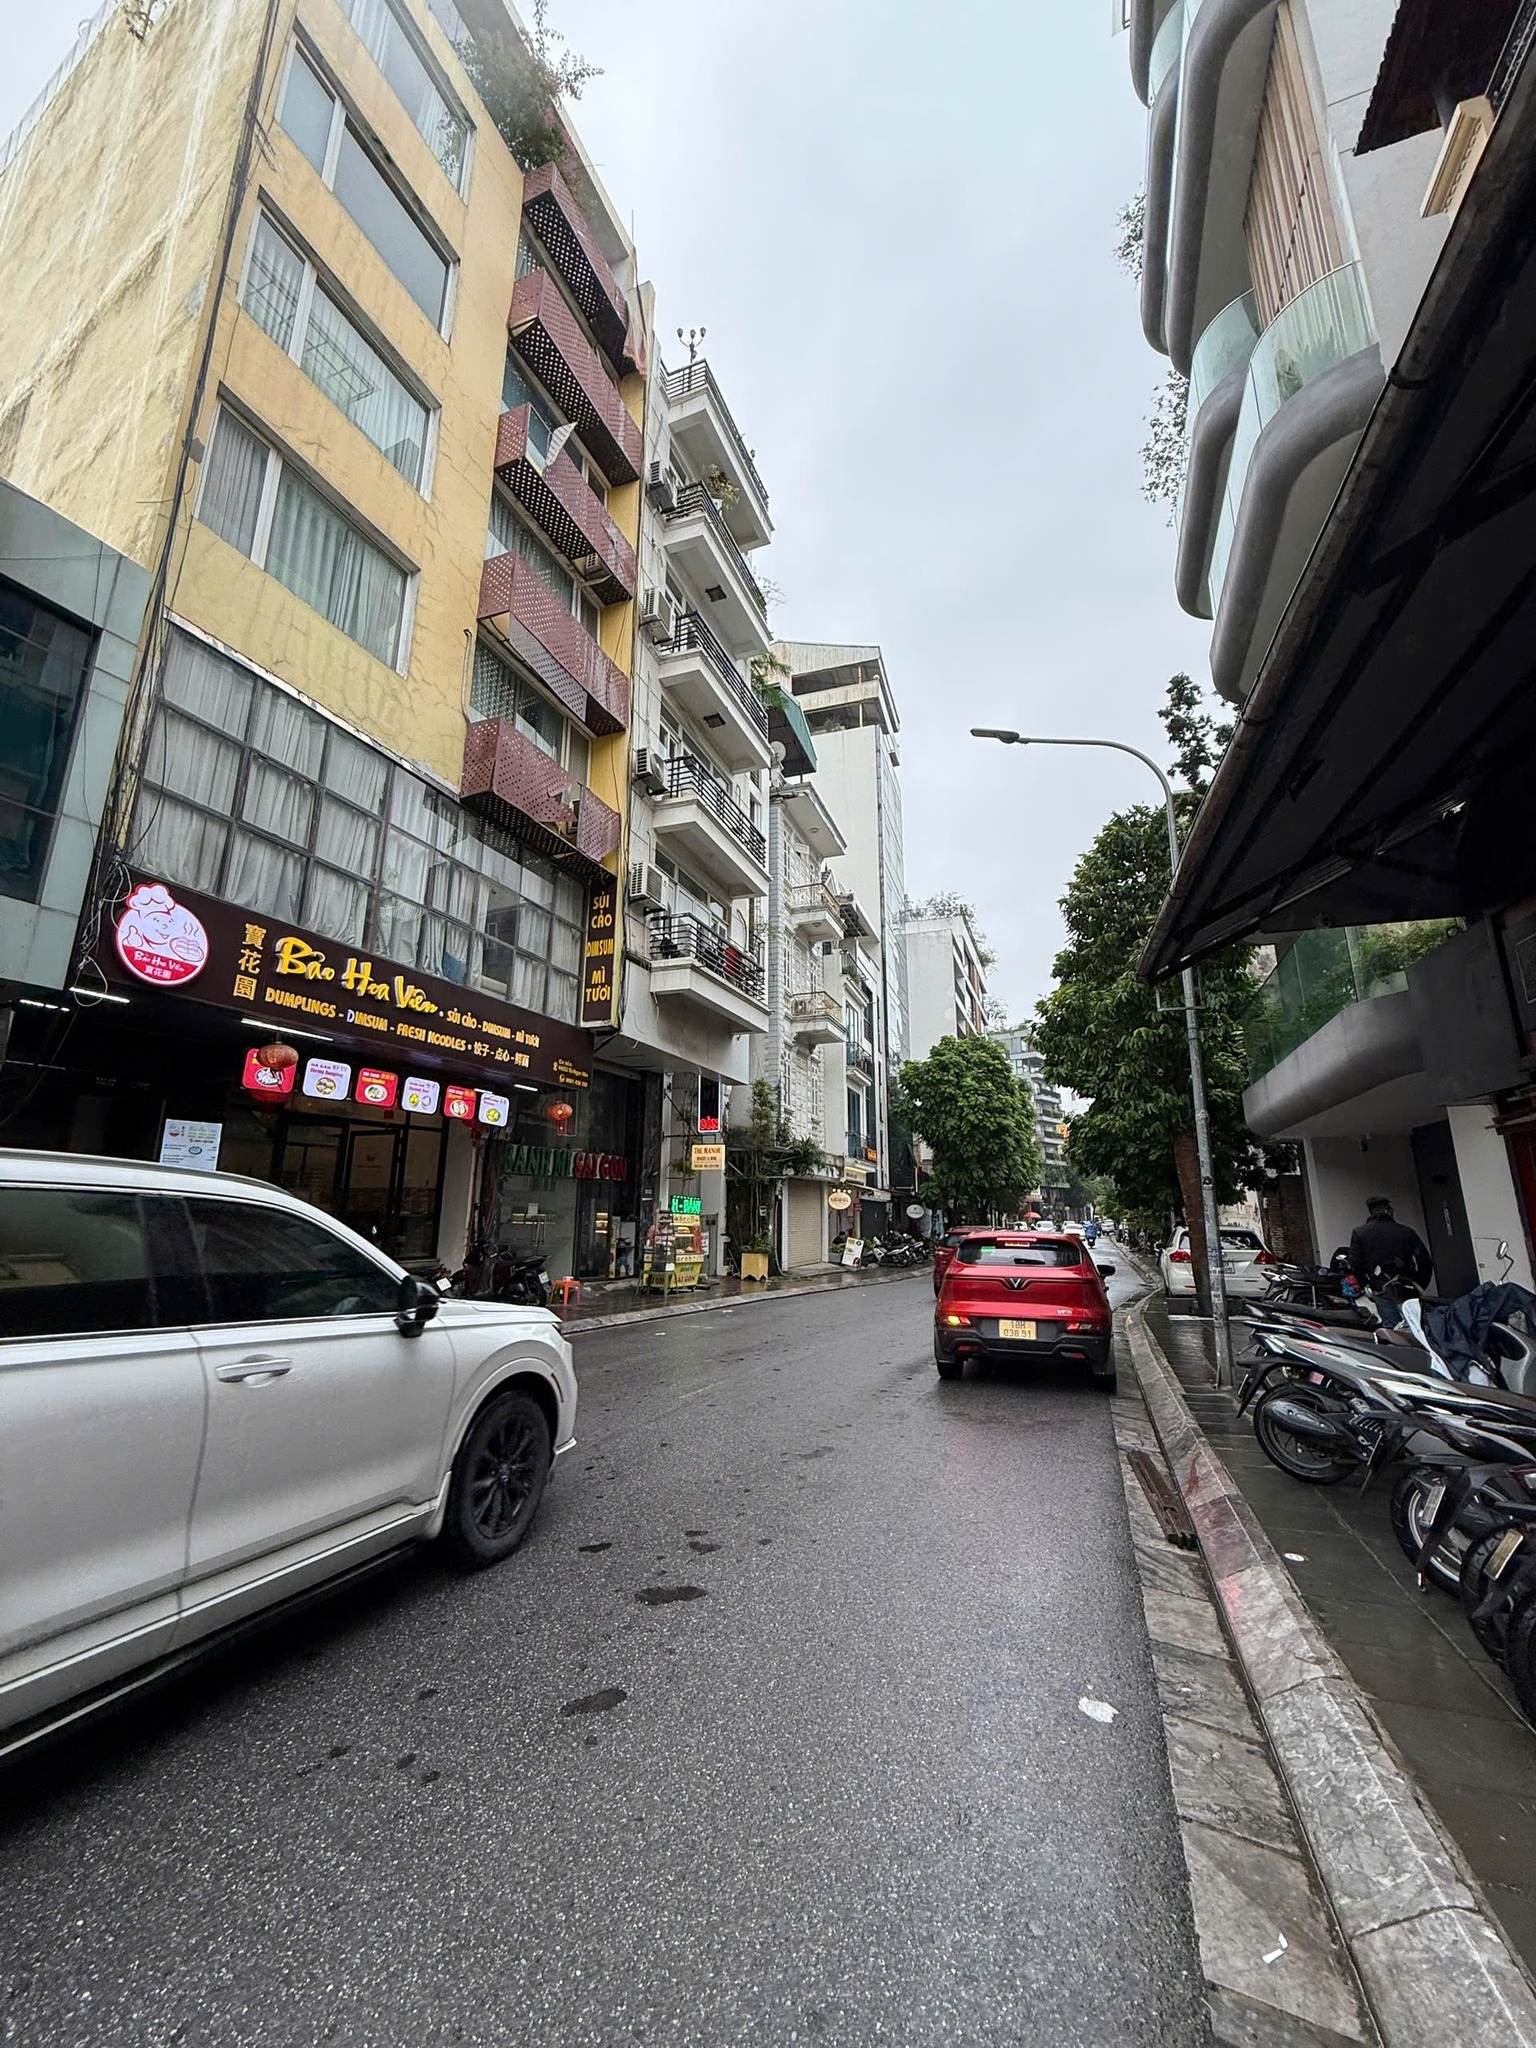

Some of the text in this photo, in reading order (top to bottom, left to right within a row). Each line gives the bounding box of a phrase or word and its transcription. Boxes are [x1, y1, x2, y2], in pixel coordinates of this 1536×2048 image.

[593, 891, 610, 910] SỦI
[591, 910, 613, 929] CẢO
[586, 938, 614, 958] DIMSUM
[591, 966, 606, 985] MÌ
[275, 936, 335, 981] Bảo
[342, 957, 390, 1000] Hoa
[394, 975, 438, 1015] Viên
[446, 1007, 461, 1025] SỦI
[461, 1012, 477, 1030] CẢO
[482, 1020, 511, 1040] DIMSUM
[585, 986, 611, 1003] TƯƠI
[265, 986, 336, 1019] DUMPLINGS
[346, 1008, 388, 1033] DIMSUM
[396, 1023, 426, 1042] FRESH
[427, 1030, 467, 1052] NOODLES
